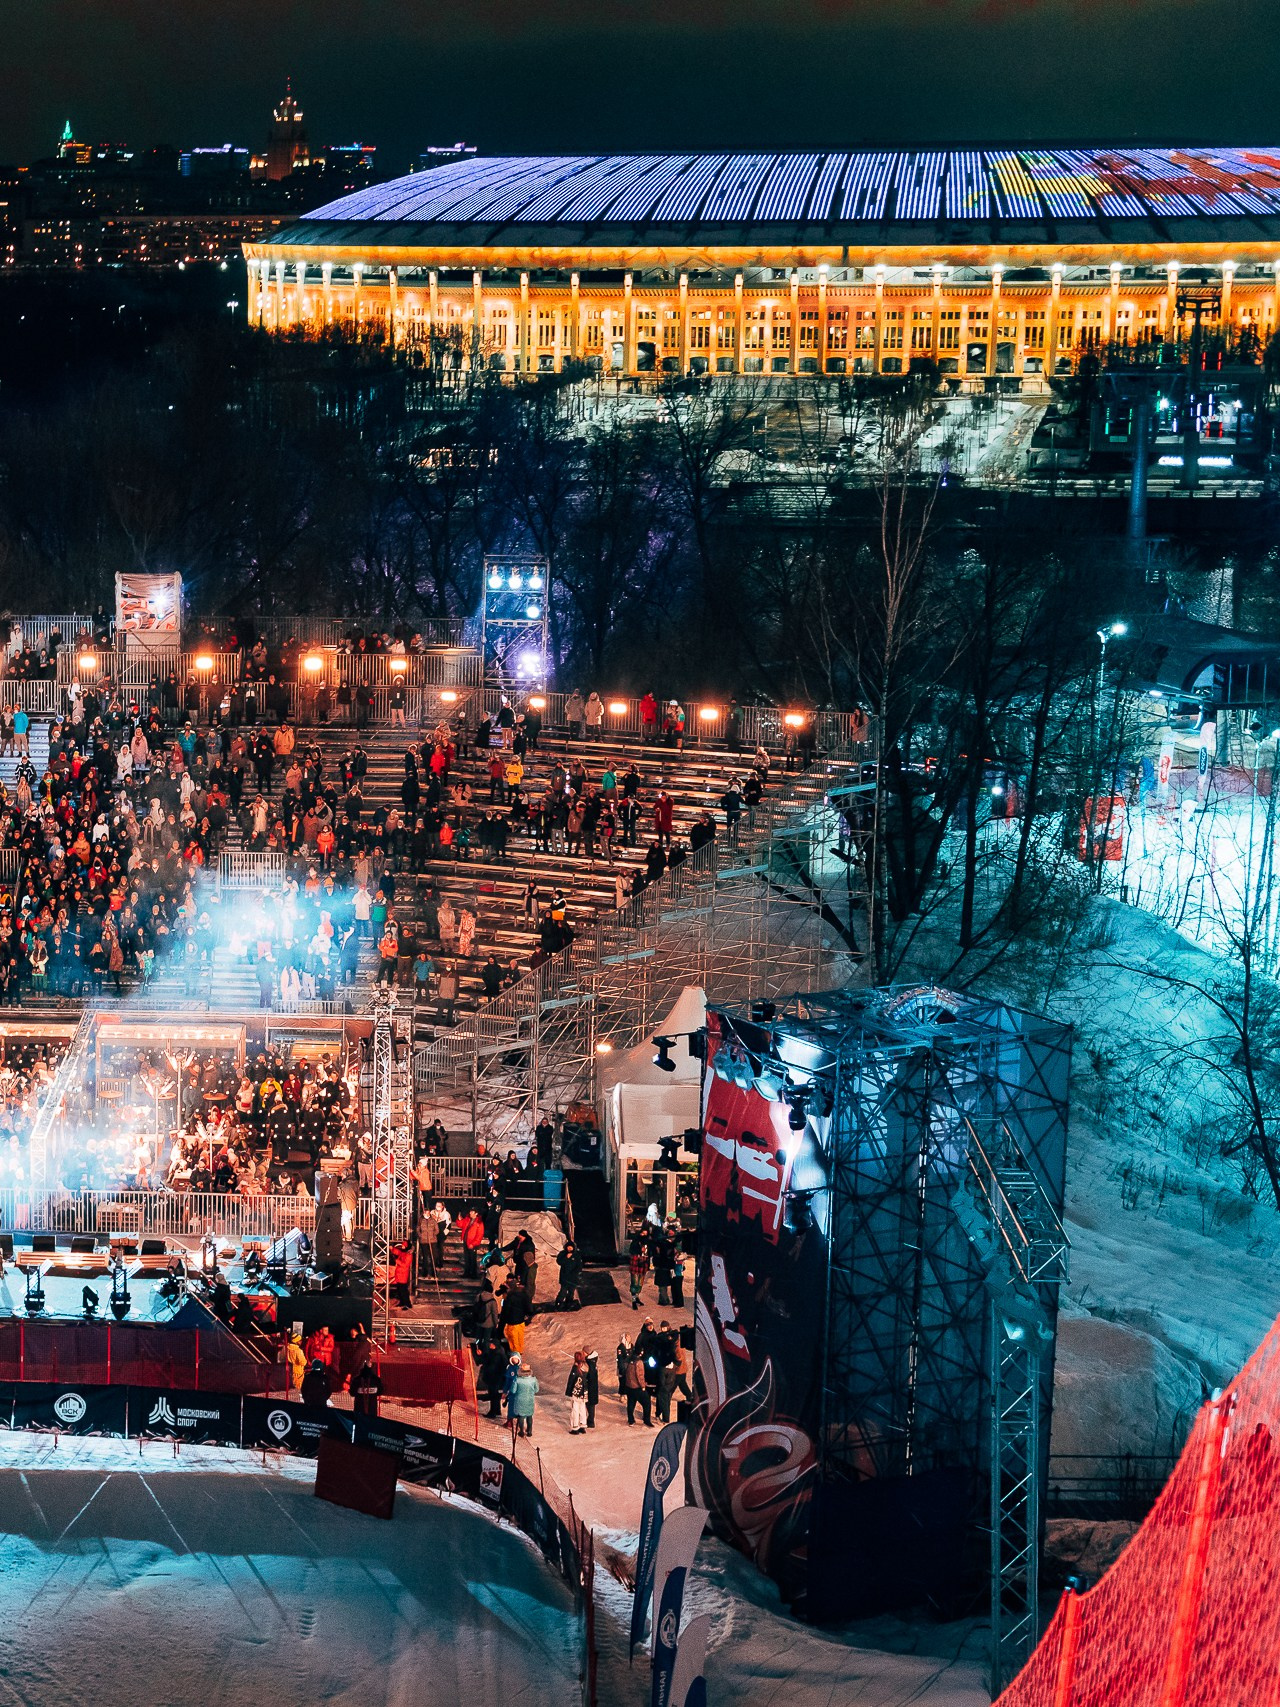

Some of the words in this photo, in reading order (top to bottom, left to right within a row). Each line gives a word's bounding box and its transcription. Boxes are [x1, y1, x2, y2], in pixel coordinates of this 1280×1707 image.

[177, 1408, 220, 1419] МОСКОВСКИЙ
[177, 1418, 197, 1428] СПОРТ
[482, 1471, 502, 1487] NRJ
